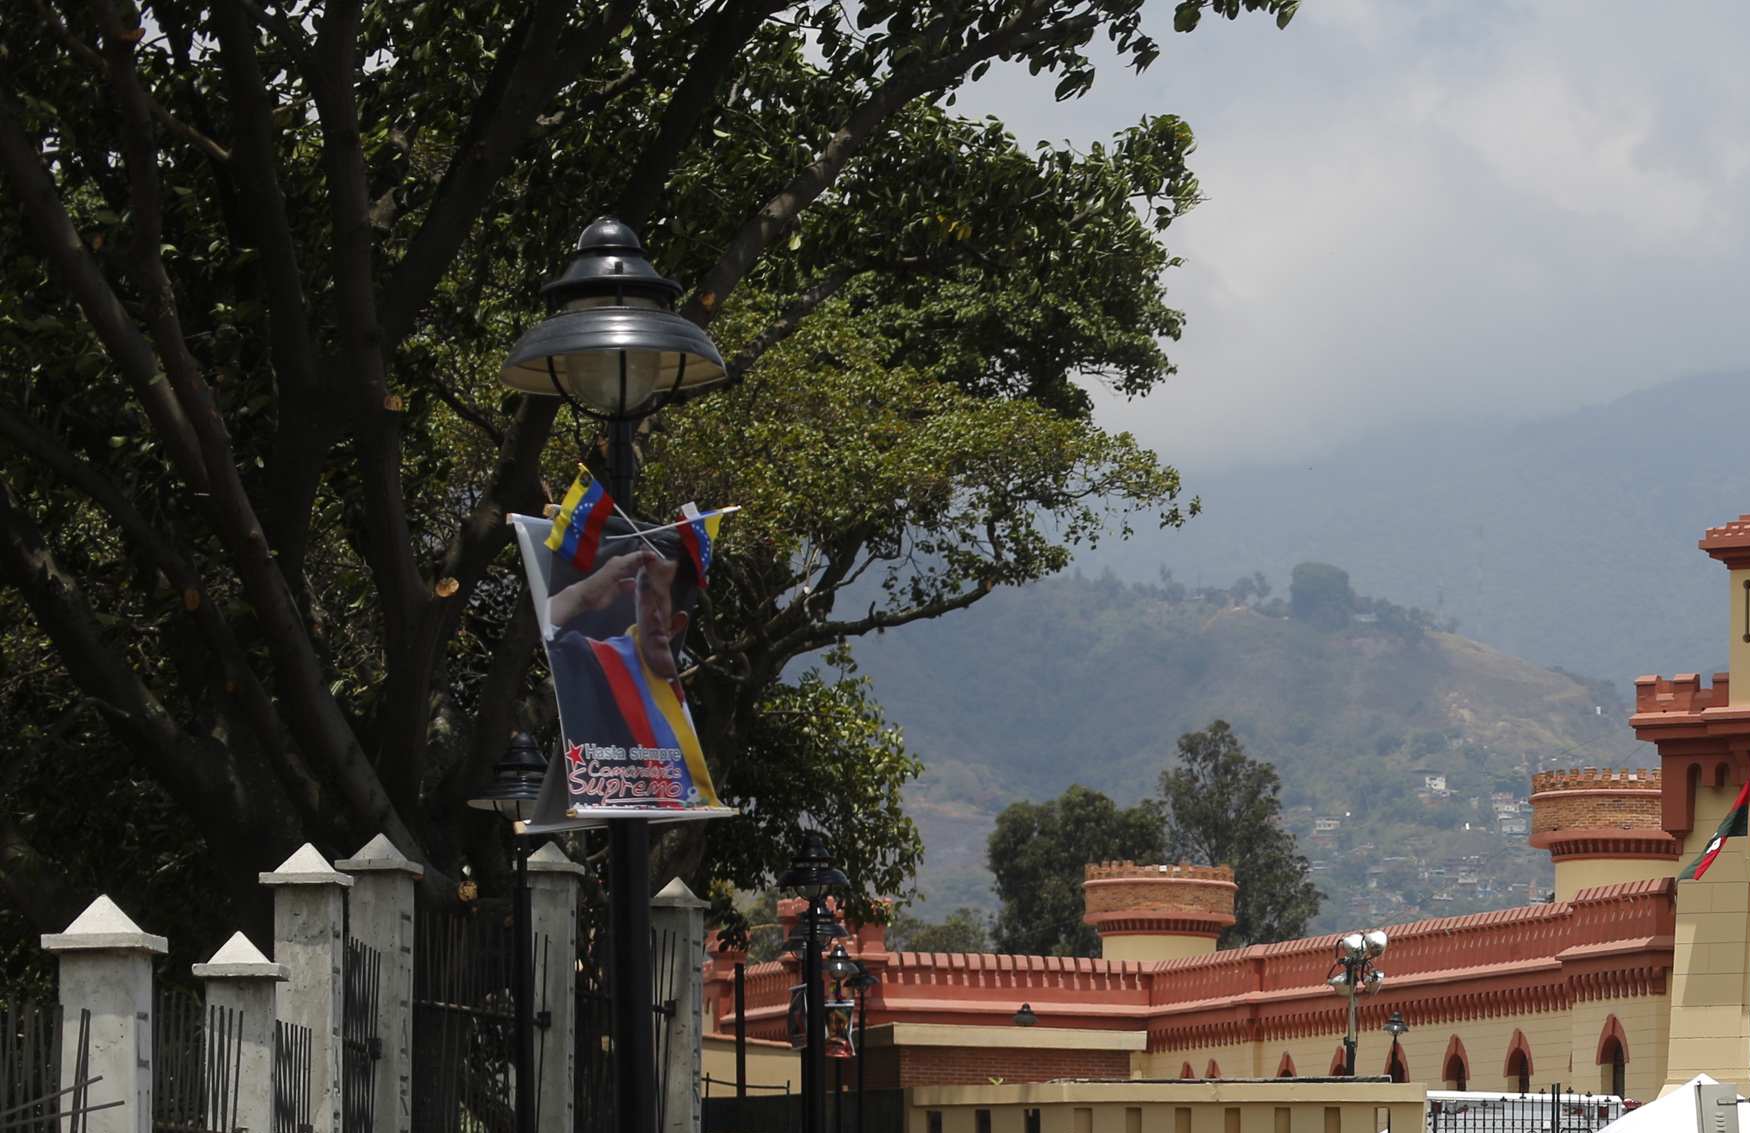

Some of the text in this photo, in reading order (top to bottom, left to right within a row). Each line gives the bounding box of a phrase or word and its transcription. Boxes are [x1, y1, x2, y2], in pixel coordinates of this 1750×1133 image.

[585, 743, 682, 761] Hasta siempre
[568, 768, 684, 803] Supremo
